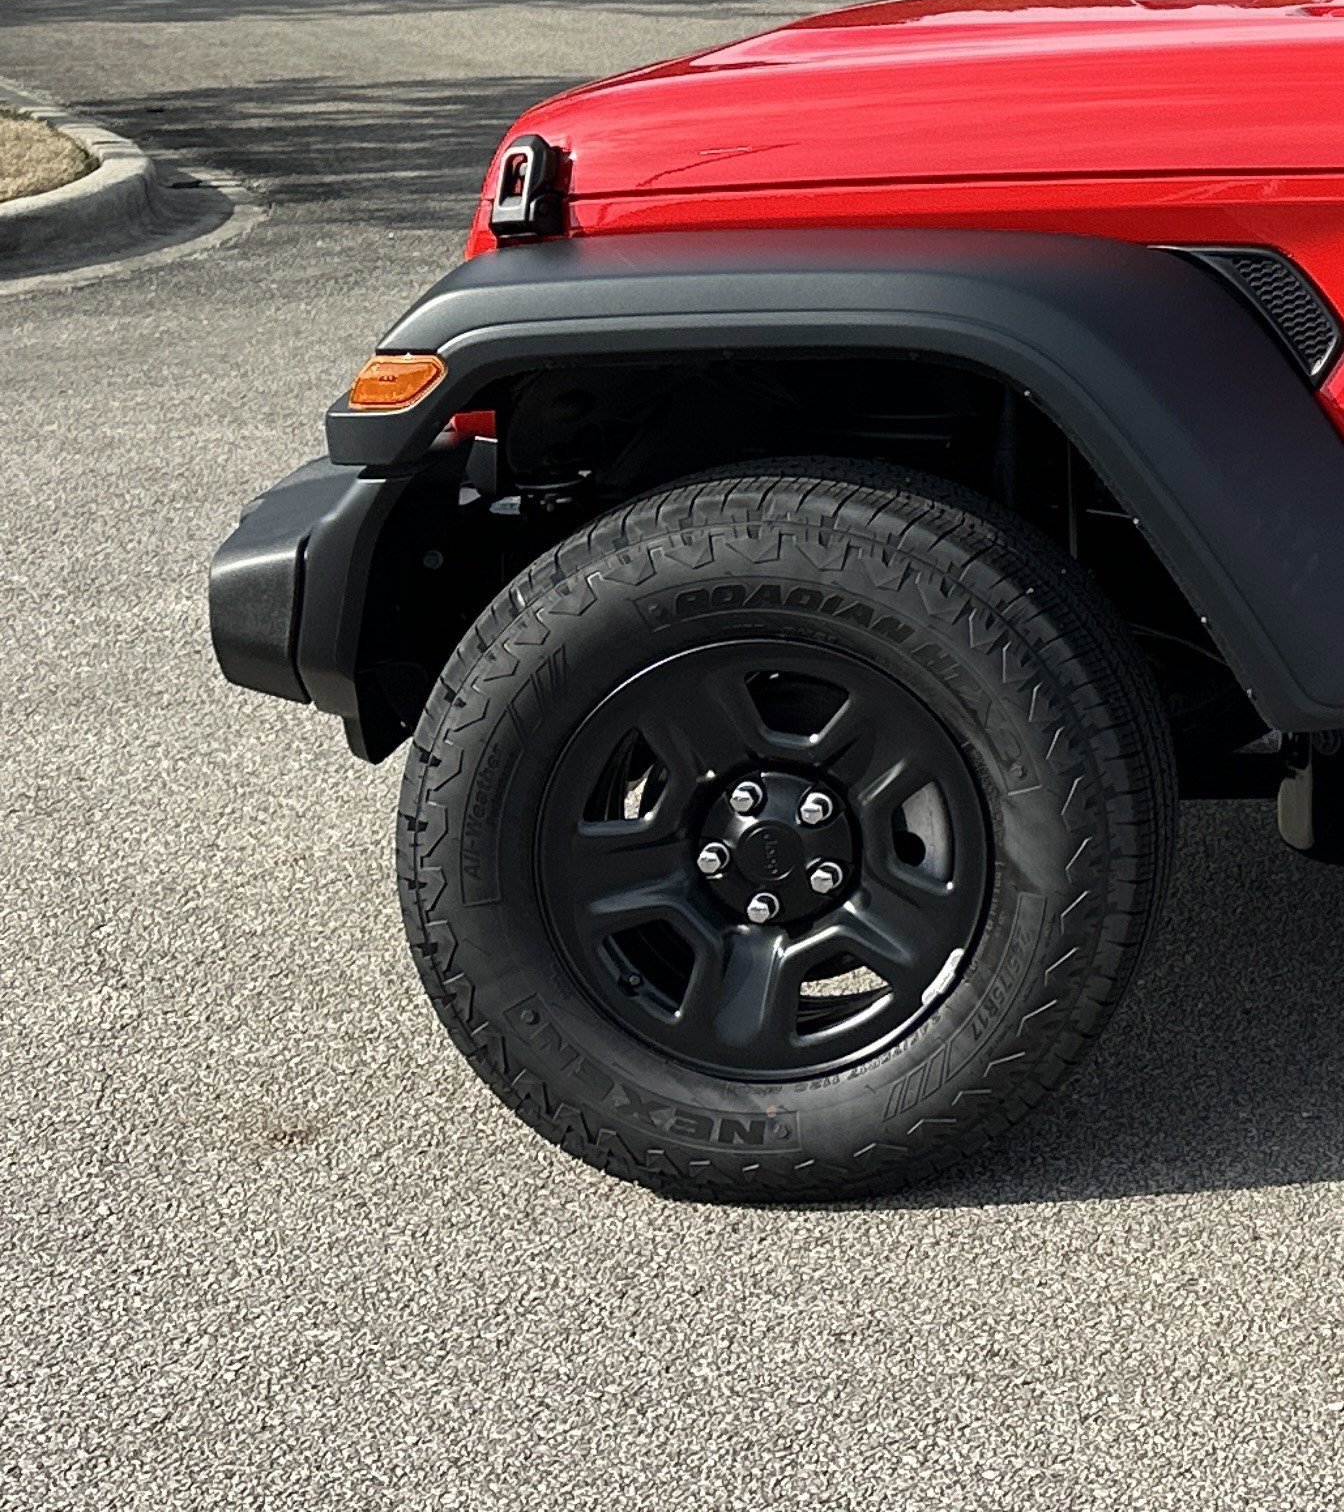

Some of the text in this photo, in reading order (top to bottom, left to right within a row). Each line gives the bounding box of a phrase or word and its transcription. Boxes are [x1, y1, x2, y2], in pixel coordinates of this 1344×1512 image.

[675, 583, 915, 646] ROADIAN
[464, 741, 503, 877] All-Weather
[970, 929, 1034, 1039] 245/75R17
[534, 1018, 765, 1148] NEXEN
